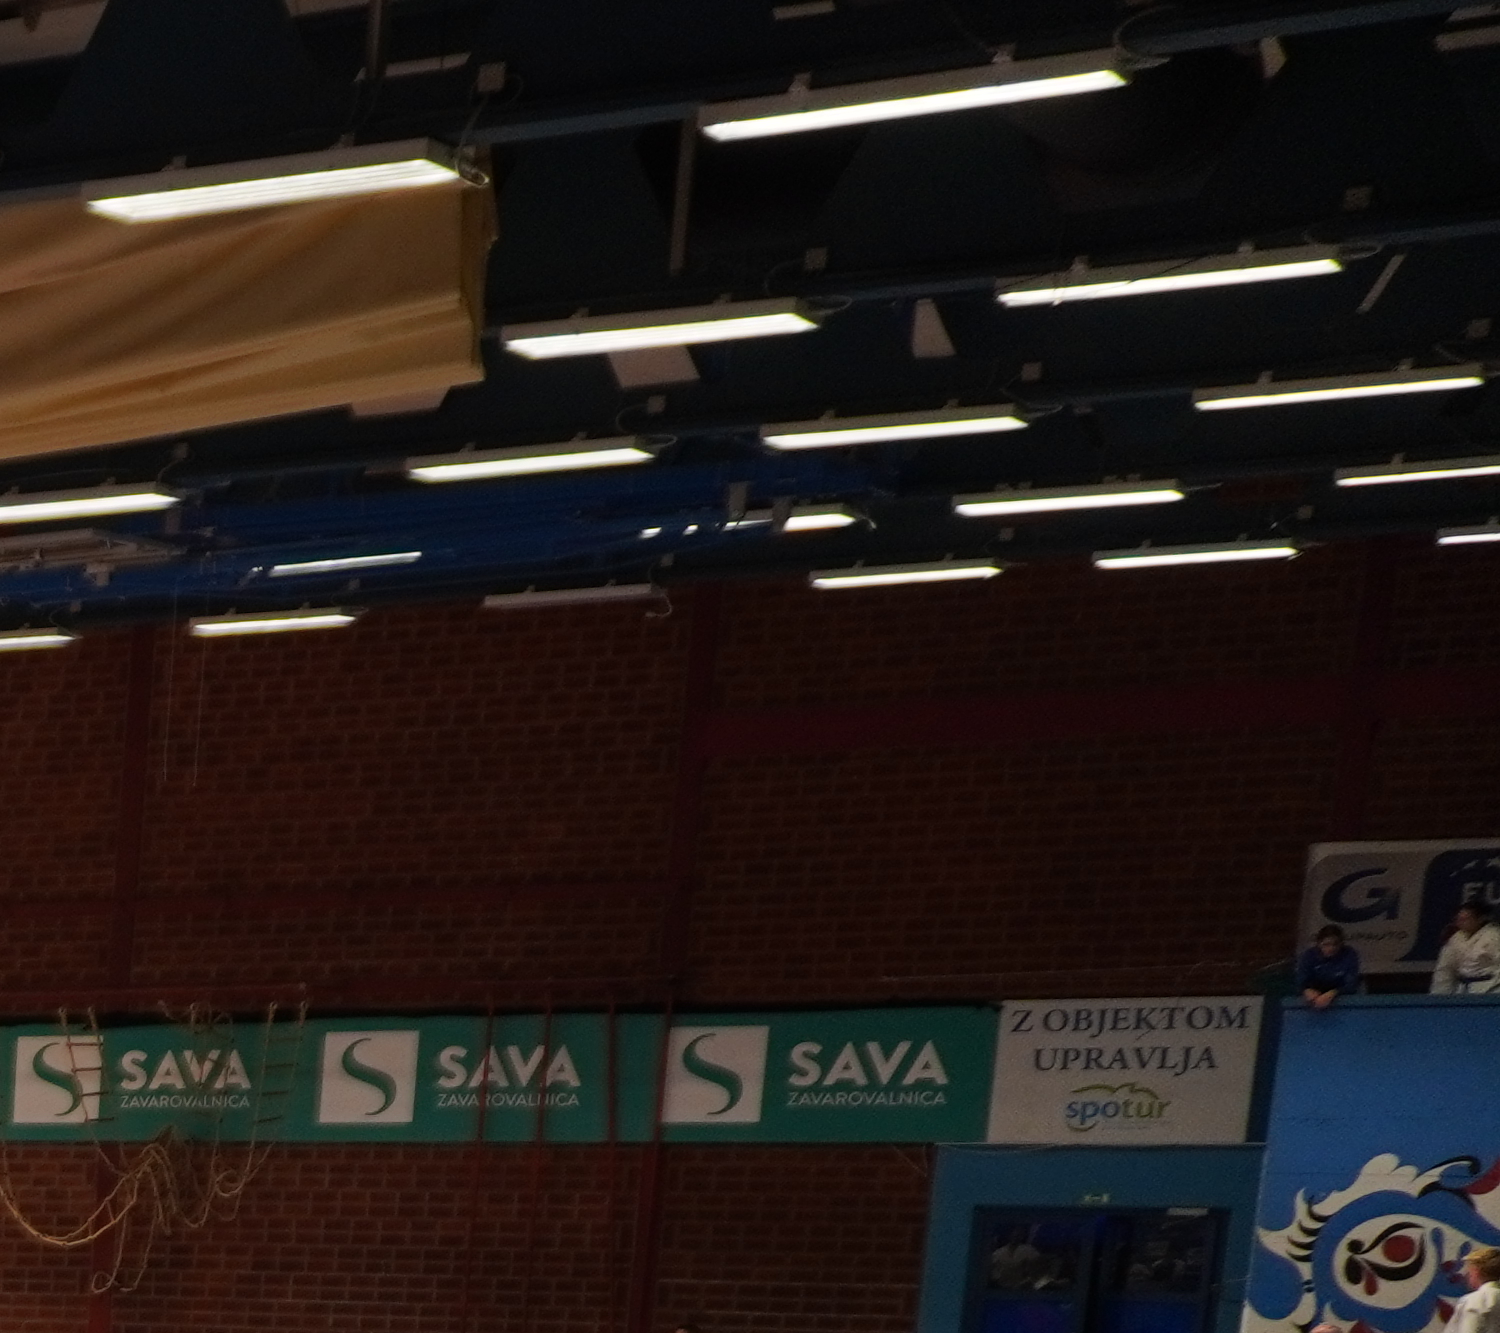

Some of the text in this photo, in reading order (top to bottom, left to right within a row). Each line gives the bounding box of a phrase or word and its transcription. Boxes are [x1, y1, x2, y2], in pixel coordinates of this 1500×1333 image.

[1012, 1005, 1251, 1034] Z OBJEKTOM
[121, 1049, 252, 1092] SAVA
[437, 1044, 581, 1090] SAVA
[788, 1041, 949, 1086] SAVA
[1034, 1045, 1219, 1076] UPRAVLJA
[120, 1094, 251, 1109] ZAVAROVALNICA
[787, 1091, 947, 1107] ZAVAROVALNICA
[1066, 1096, 1171, 1125] spotur
